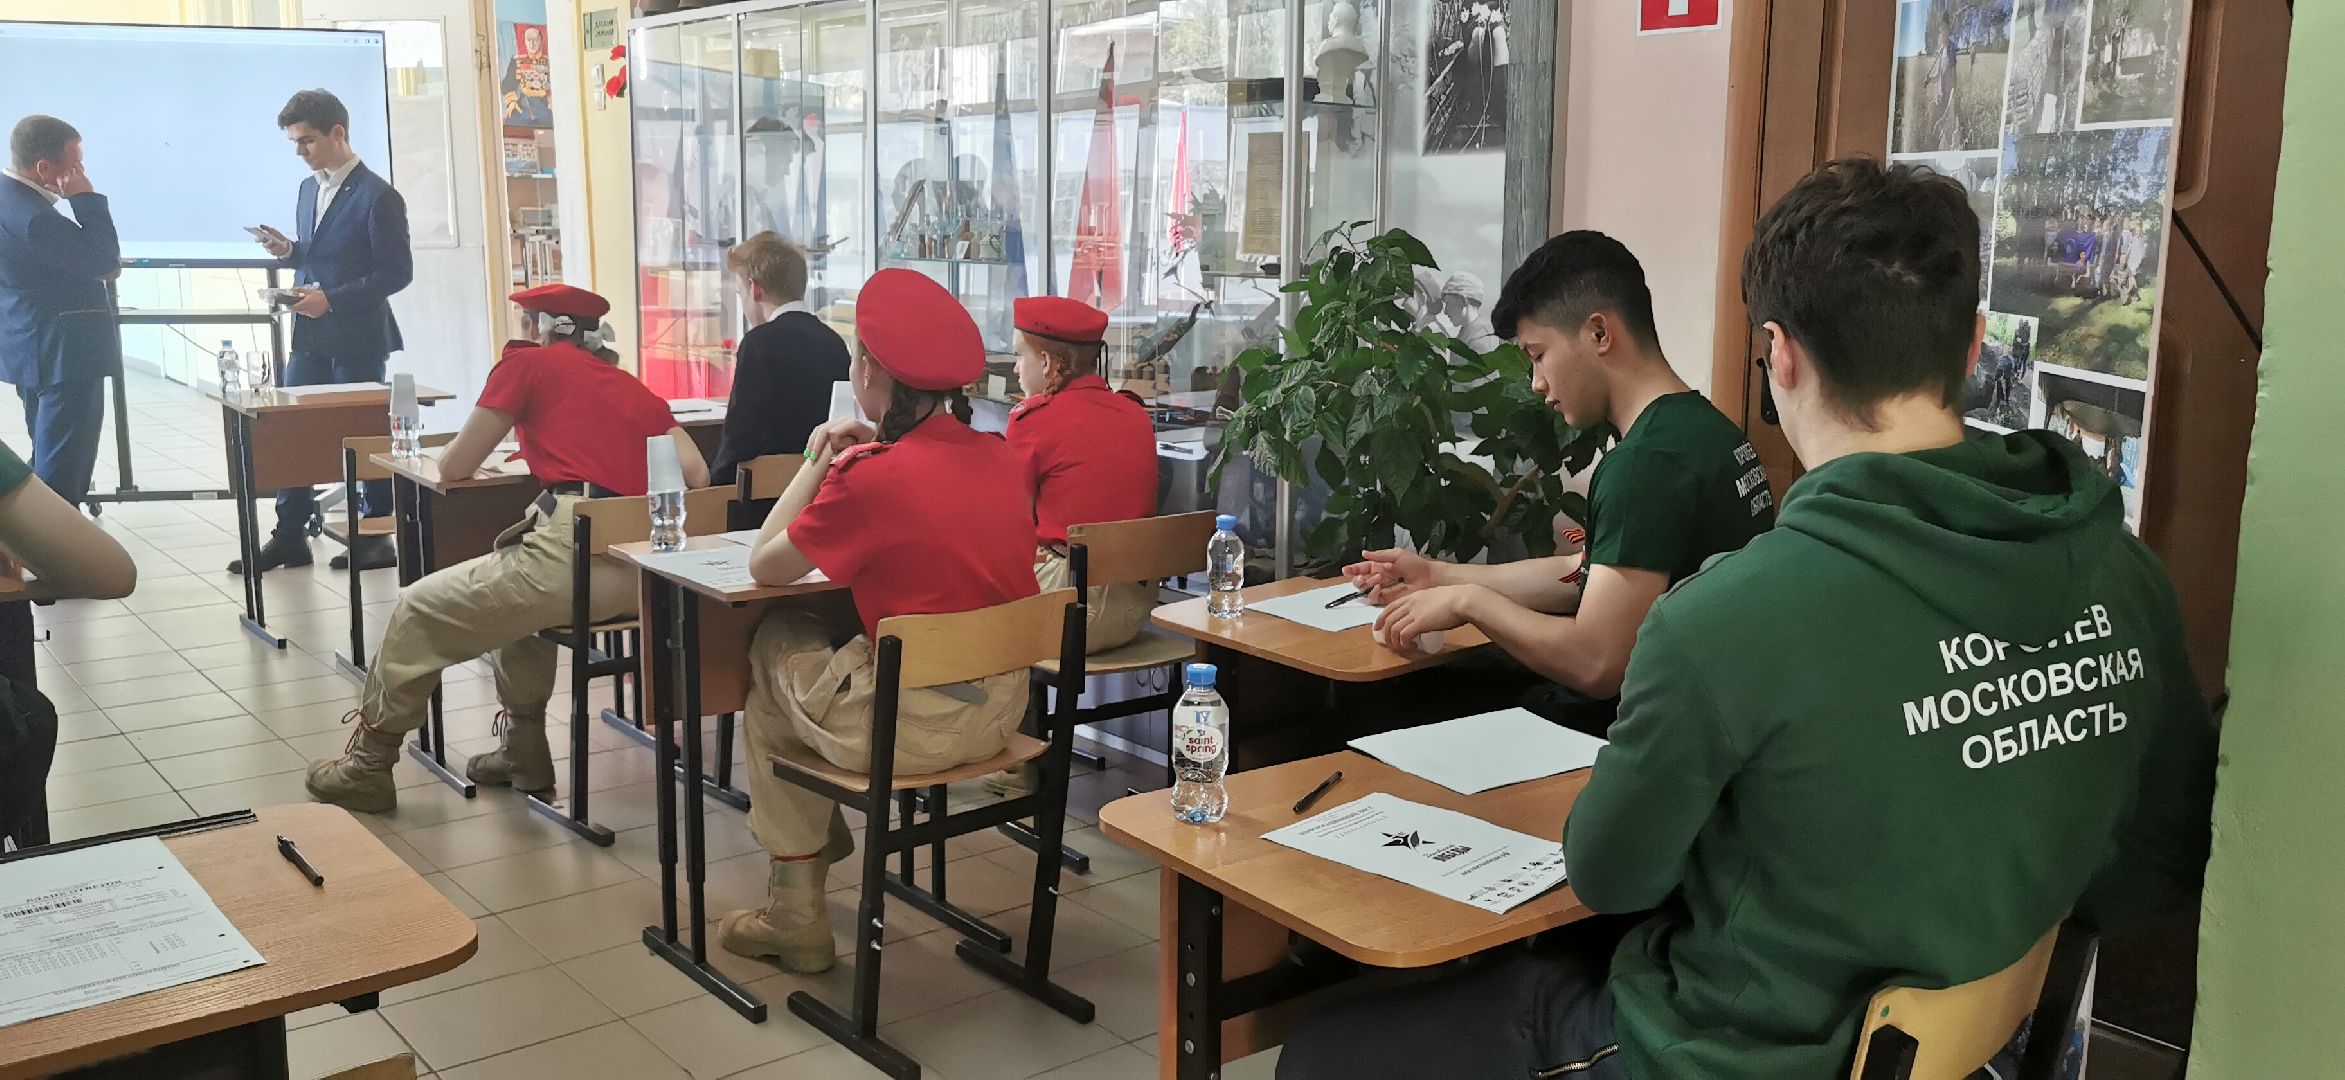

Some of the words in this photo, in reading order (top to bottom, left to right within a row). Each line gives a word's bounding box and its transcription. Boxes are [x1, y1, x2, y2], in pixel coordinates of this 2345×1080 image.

[1939, 604, 2113, 674] КОРЁВ
[1903, 647, 2145, 737] МОСКОВСКАЯ
[1185, 744, 1217, 755] spring
[1188, 735, 1214, 745] saint
[1962, 701, 2129, 770] ОБЛАСТЬ
